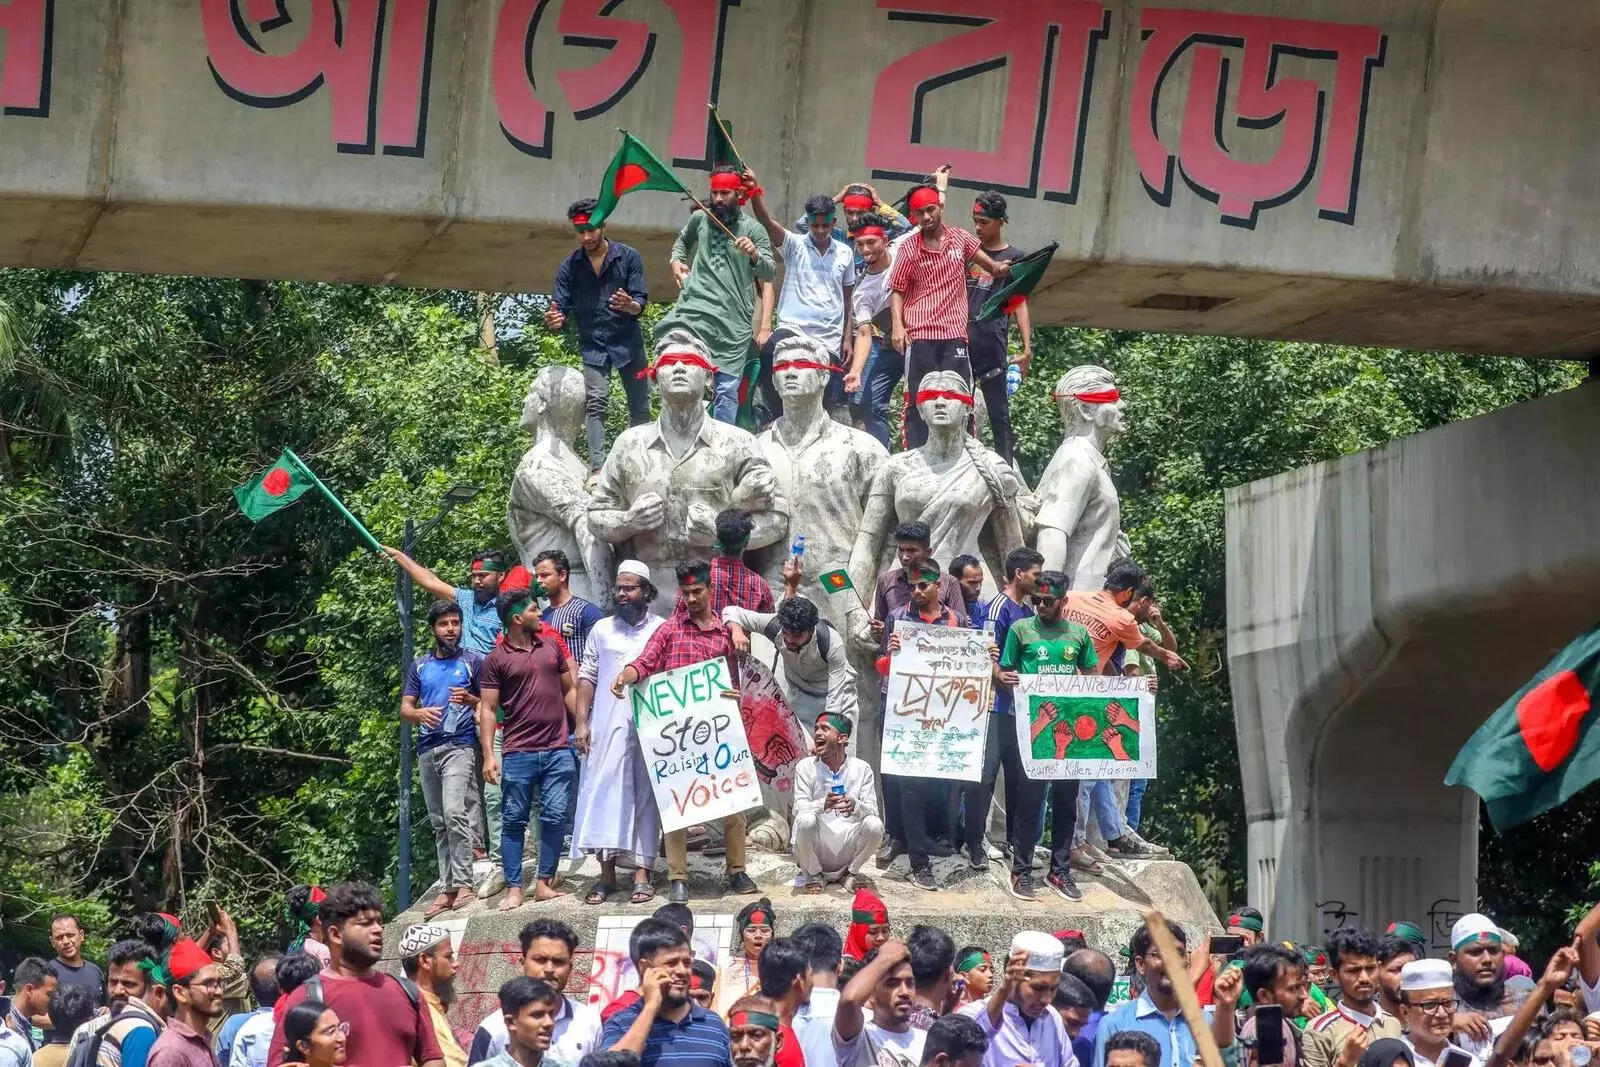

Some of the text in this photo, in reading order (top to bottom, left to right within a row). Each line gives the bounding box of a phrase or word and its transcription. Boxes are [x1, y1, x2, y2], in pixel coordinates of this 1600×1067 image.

[1069, 609, 1111, 640] ESSENTIALS
[631, 662, 732, 729] NEVER
[1019, 674, 1047, 694] WE
[1053, 674, 1097, 693] WANT
[651, 743, 750, 784] Raising Our
[1097, 760, 1138, 777] Hasina
[670, 771, 750, 817] Voice
